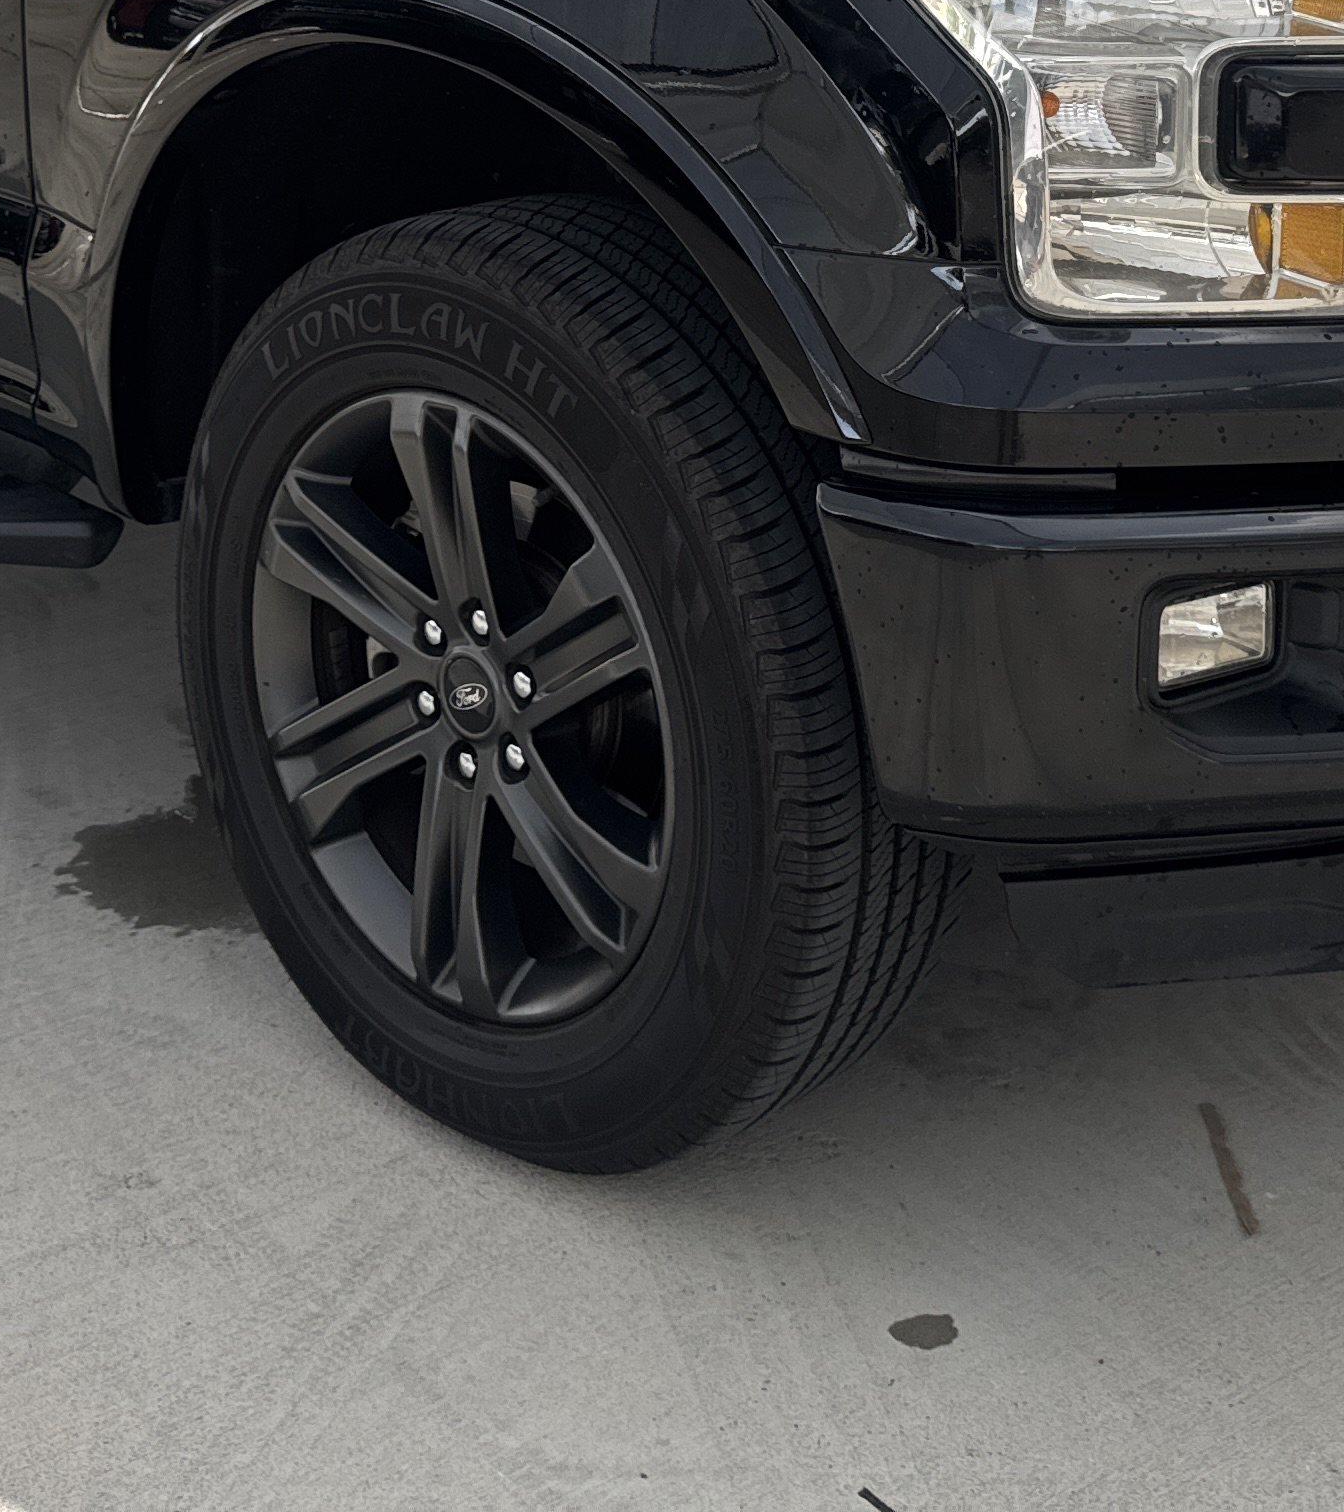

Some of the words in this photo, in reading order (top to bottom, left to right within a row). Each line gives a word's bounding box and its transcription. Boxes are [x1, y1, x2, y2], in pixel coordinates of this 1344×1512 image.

[260, 293, 490, 381] LIONCLAW
[504, 340, 579, 418] HT
[456, 687, 481, 707] Ford
